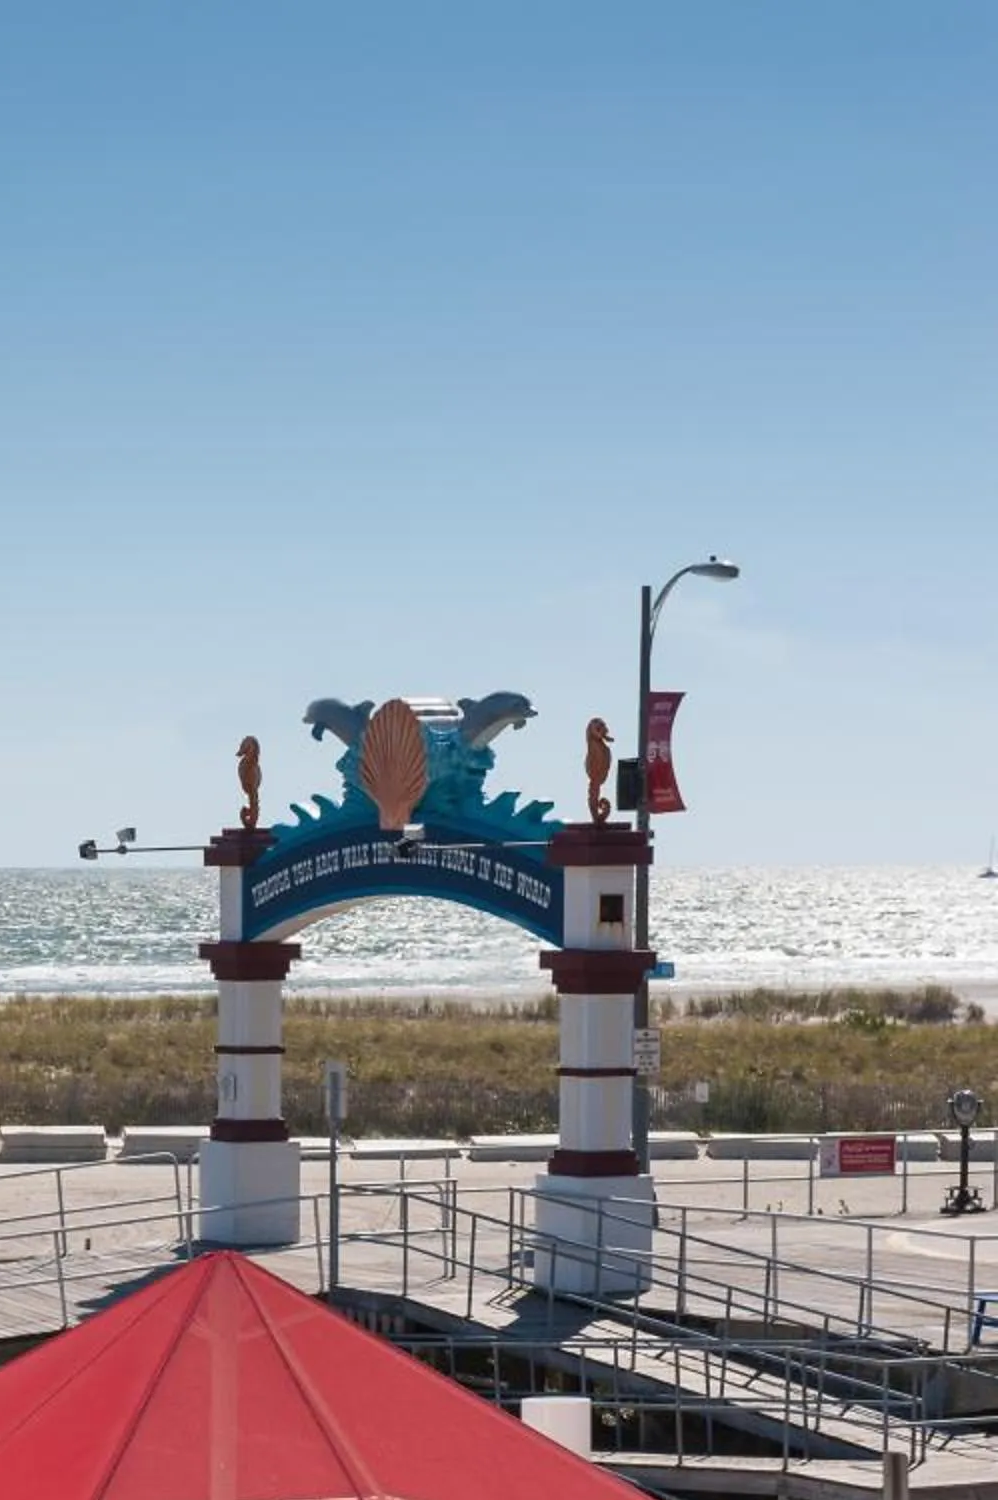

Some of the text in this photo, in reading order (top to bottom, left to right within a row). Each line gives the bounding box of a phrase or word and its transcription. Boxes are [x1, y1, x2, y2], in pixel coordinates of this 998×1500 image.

[292, 859, 314, 887] THIS
[315, 850, 340, 877] ARCH
[341, 843, 370, 869] WALK
[440, 848, 476, 877] PEOPLE
[477, 857, 492, 882] IN
[492, 861, 514, 891] THE
[515, 871, 552, 909] WORLD
